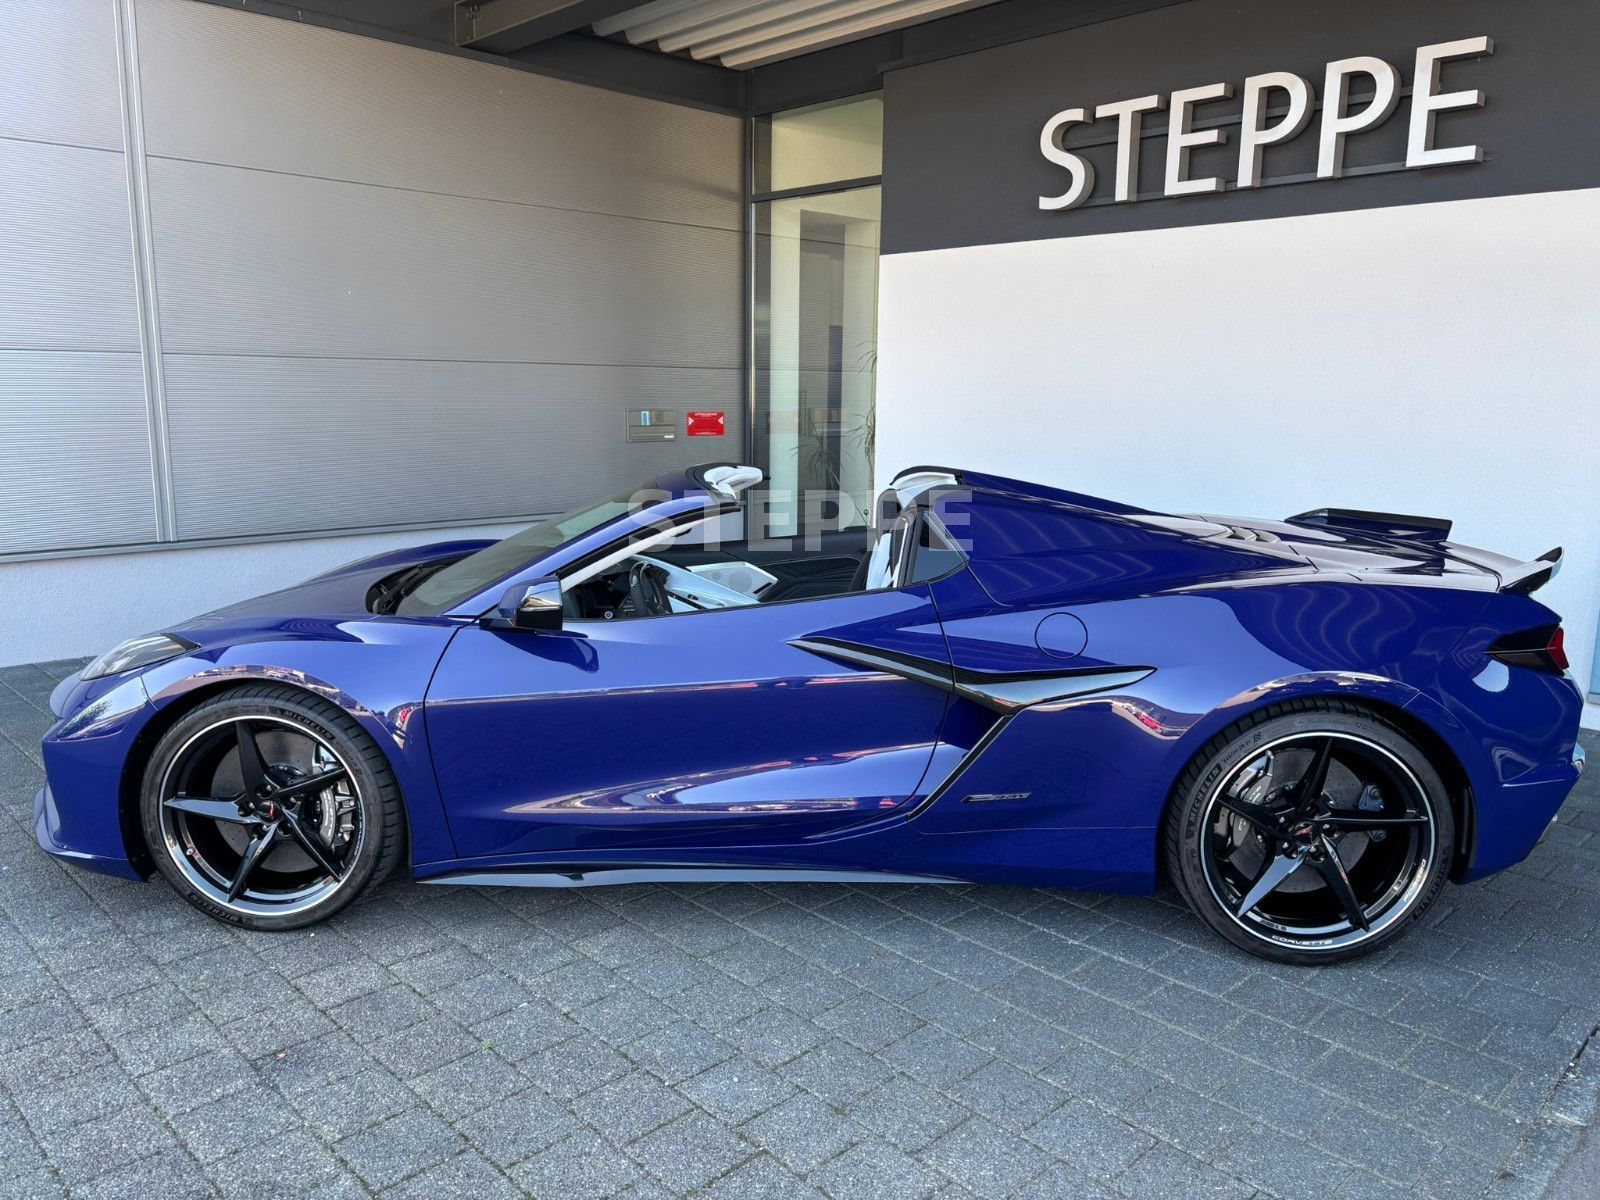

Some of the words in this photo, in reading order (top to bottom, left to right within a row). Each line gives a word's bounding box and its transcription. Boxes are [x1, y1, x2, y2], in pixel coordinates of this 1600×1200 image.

[1038, 35, 1494, 211] STEPPE
[281, 709, 334, 739] MICHELIN
[1188, 765, 1221, 824] MICHELIN
[189, 893, 240, 921] MICHELIN
[1271, 935, 1333, 945] CORVETTE
